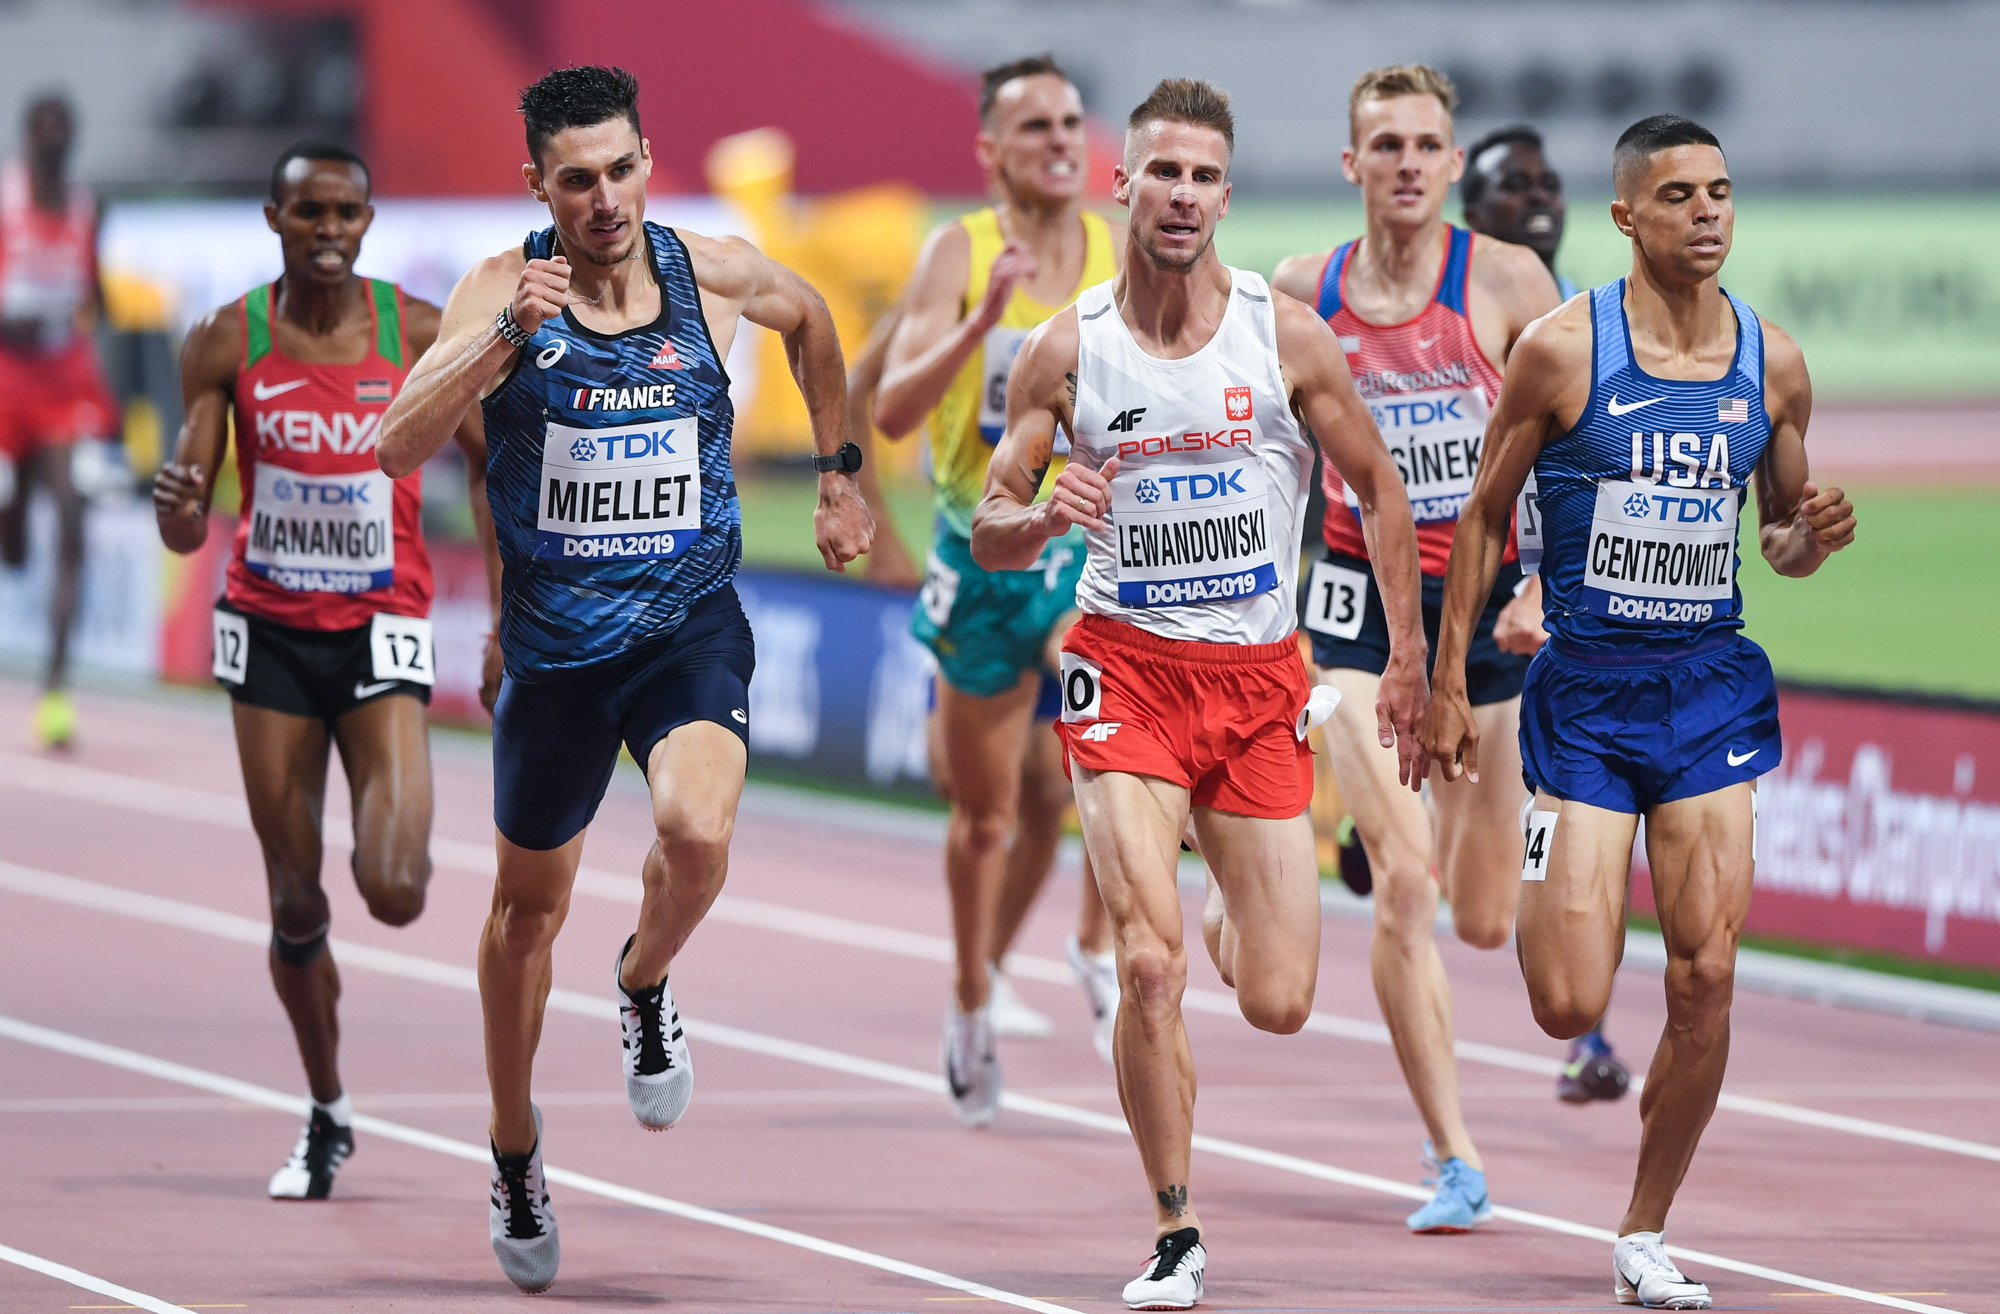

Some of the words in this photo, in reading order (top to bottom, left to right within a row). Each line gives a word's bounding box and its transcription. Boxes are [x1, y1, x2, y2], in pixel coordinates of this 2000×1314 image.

[652, 353, 678, 366] MAIF
[587, 384, 676, 411] FRANCE
[1384, 396, 1463, 427] TDK
[597, 428, 677, 461] TDK
[1118, 428, 1251, 460] POLSKA
[1390, 434, 1481, 486] SÍNEK
[1630, 432, 1731, 489] USA
[295, 481, 371, 505] TDK
[547, 474, 692, 523] MIELLET
[1158, 468, 1247, 502] TDK
[1651, 495, 1727, 523] TDK
[252, 511, 386, 559] MANANGOI
[563, 534, 675, 558] DOHA2019
[1118, 508, 1267, 568] LEWANDOWSKI
[1592, 533, 1730, 587] CENTROWITZ
[268, 566, 373, 593] DOHA2019
[1145, 573, 1257, 604] DOHA2019
[1323, 581, 1355, 624] 13
[1607, 595, 1713, 623] DOHA2019
[219, 628, 241, 669] 12
[385, 634, 424, 670] 12
